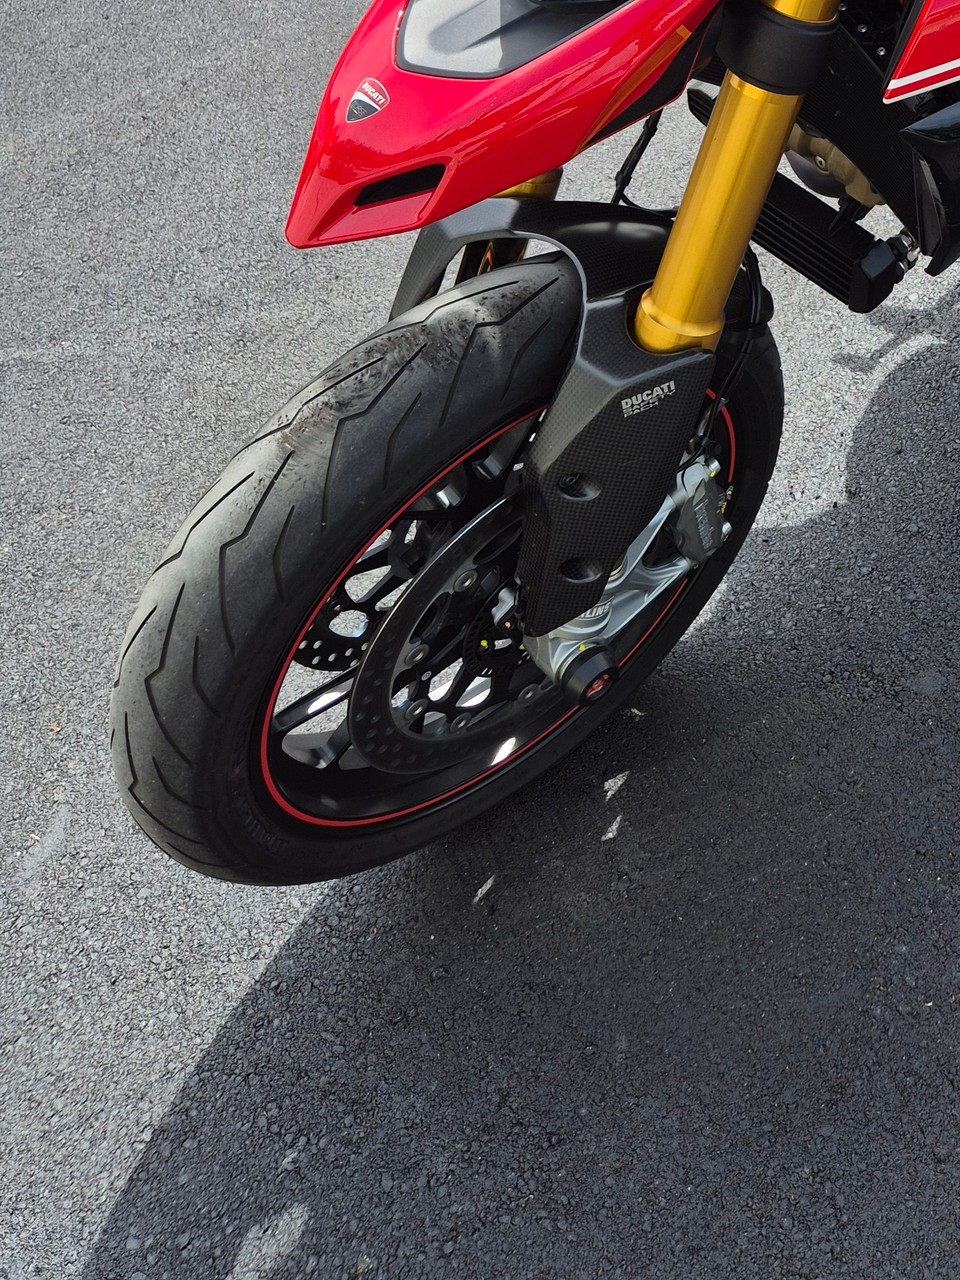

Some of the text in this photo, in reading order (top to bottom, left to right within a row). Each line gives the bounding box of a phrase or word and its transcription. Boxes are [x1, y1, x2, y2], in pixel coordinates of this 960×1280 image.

[361, 81, 386, 104] DUCATI
[621, 380, 676, 409] DUCATI
[580, 602, 611, 618] LINS
